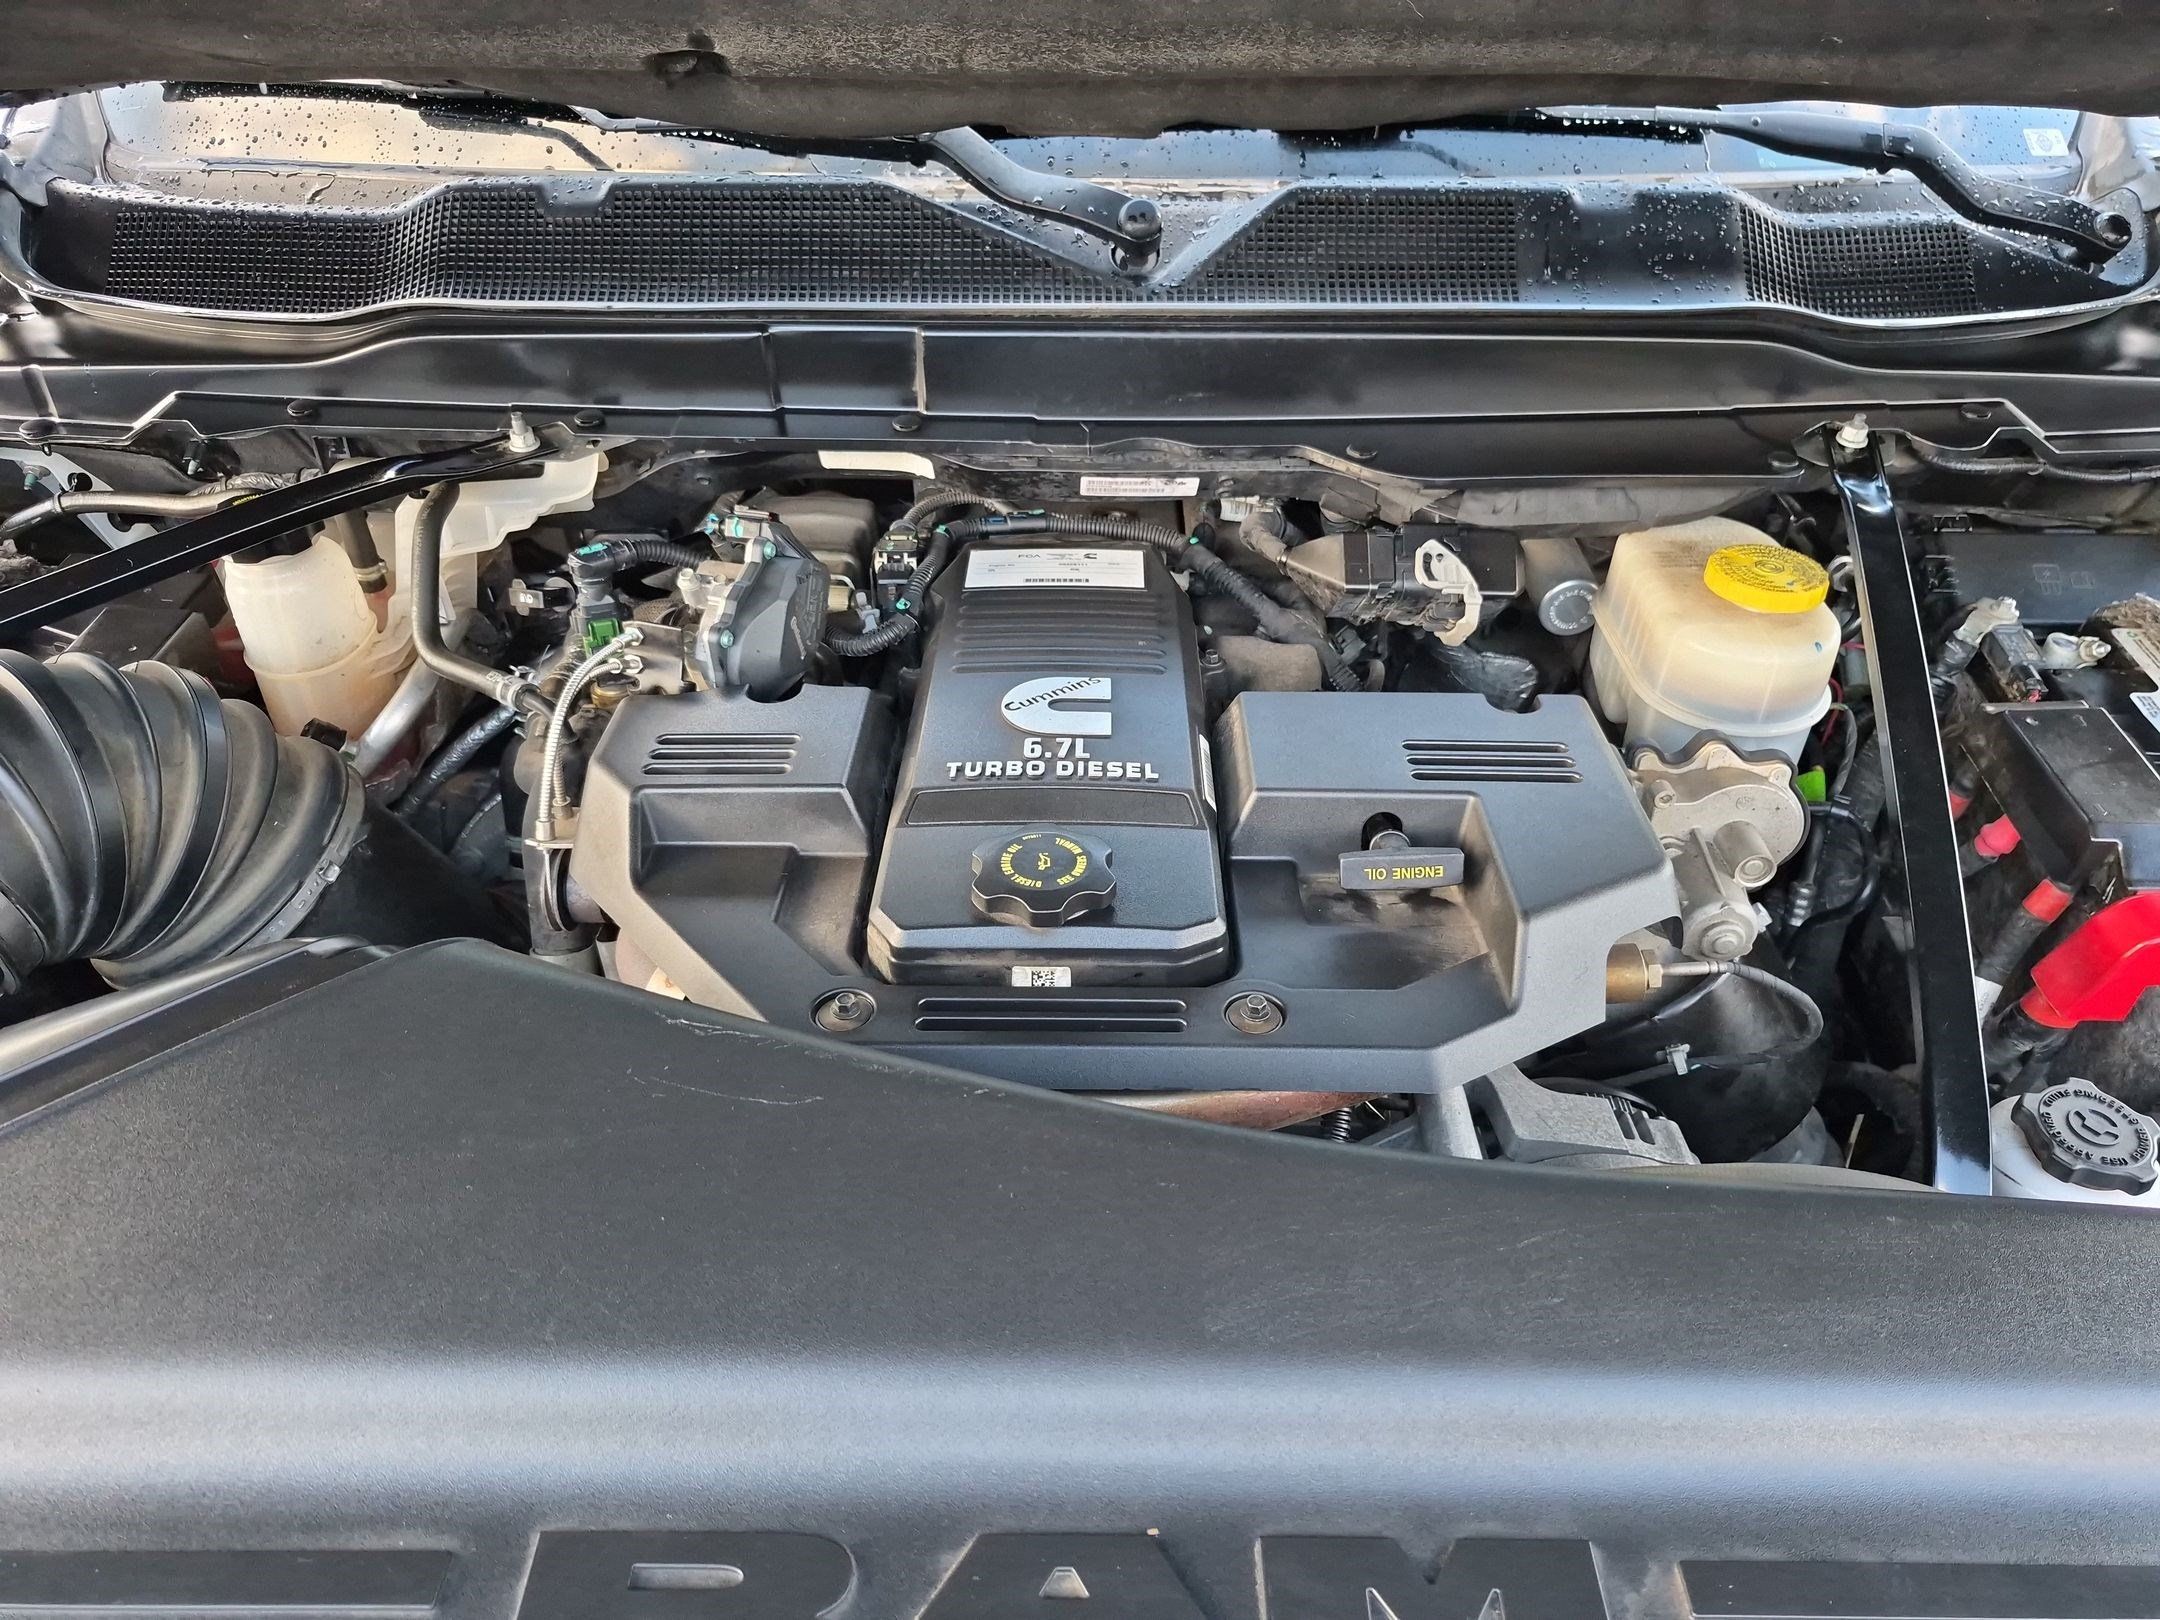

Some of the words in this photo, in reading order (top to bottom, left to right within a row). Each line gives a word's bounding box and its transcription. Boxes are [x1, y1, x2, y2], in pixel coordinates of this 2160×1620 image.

[1003, 676, 1103, 713] Cummins
[1023, 737, 1091, 759] 6.7L
[946, 760, 1047, 780] TURBO
[1055, 760, 1160, 782] DIESEL
[1011, 874, 1042, 888] DIESEL
[1056, 875, 1075, 886] SEE
[1364, 867, 1387, 880] OIL
[1391, 865, 1444, 880] ENGINE
[2130, 1126, 2152, 1162] POWER
